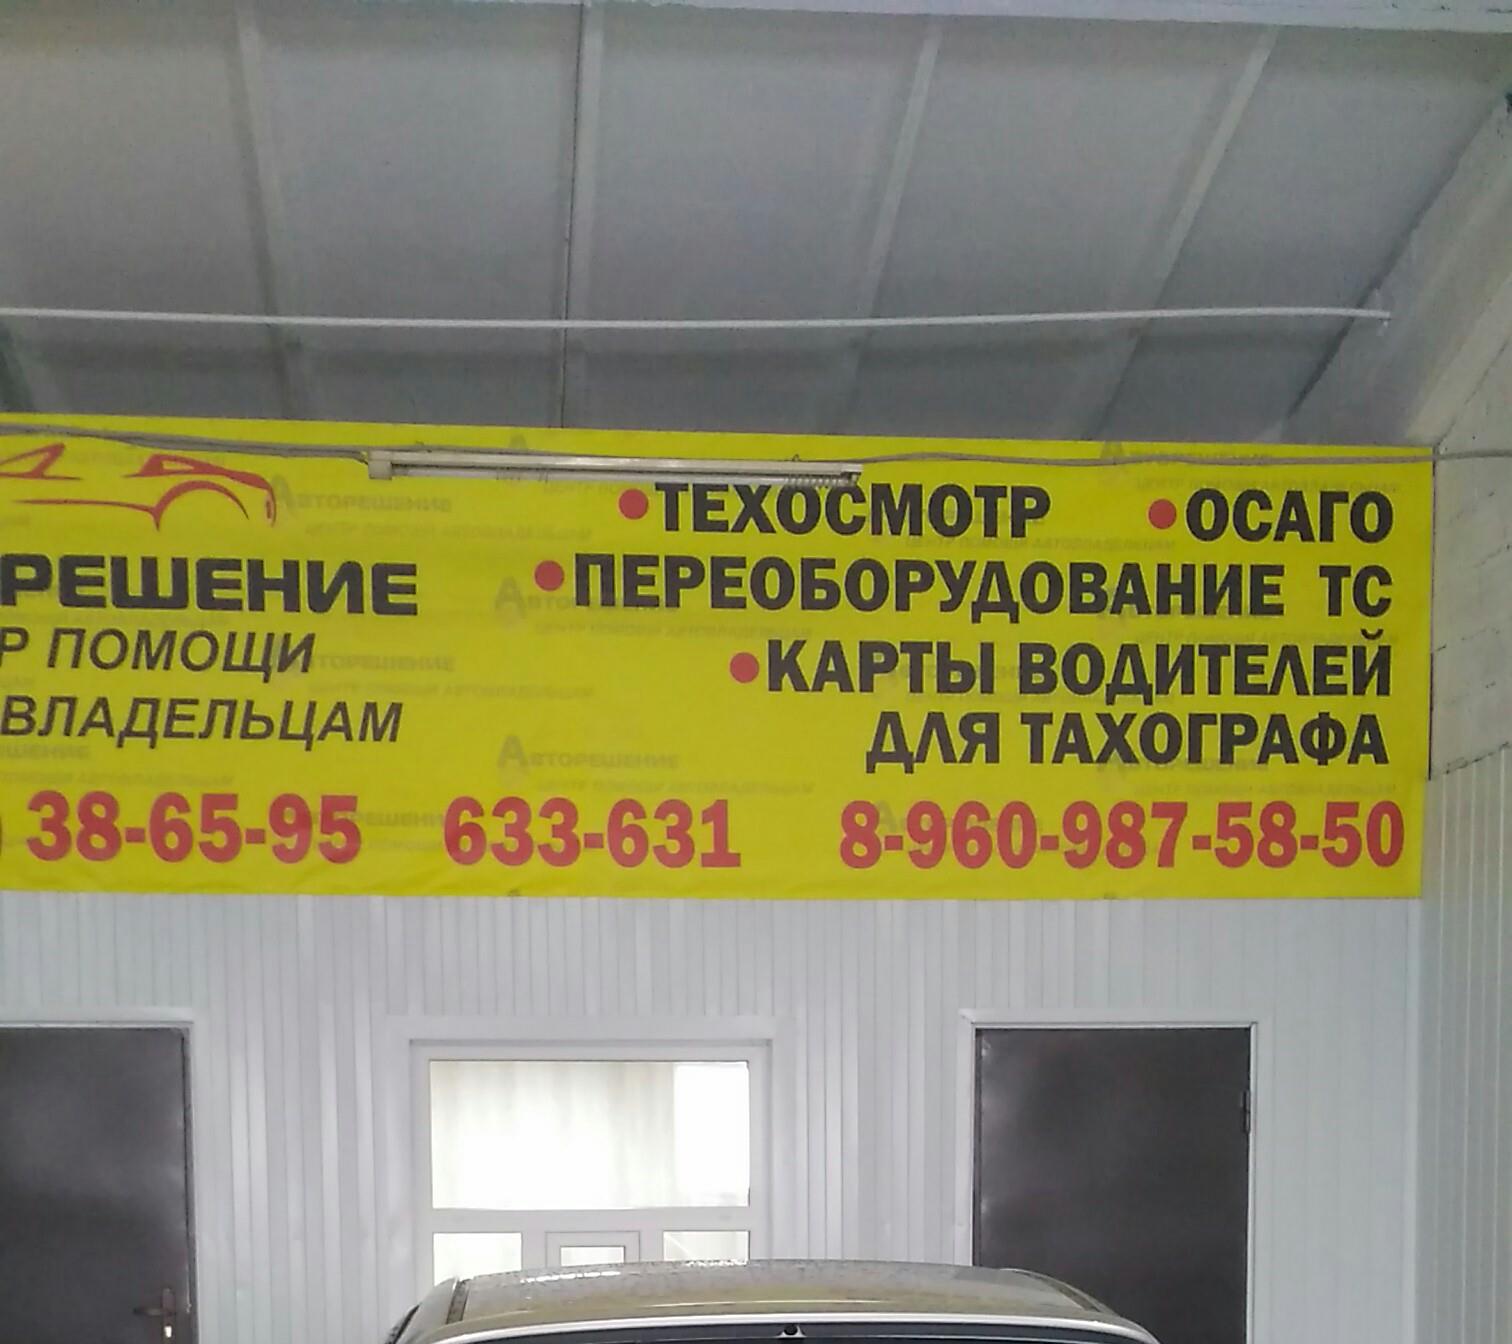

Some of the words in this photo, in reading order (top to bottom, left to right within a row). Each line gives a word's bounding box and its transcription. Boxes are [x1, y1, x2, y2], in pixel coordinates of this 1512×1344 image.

[654, 482, 1051, 538] ТЕХОСМОТР
[1186, 487, 1394, 543] ОСАГО
[0, 553, 418, 617] РЕШЕНИЕ
[574, 552, 1285, 624] ПЕРЕОБОРУДОВАНИЕ
[1318, 564, 1393, 617] ТС
[47, 627, 316, 683] ПОМОЩИ
[767, 639, 995, 694] КАРТЫ
[1018, 628, 1392, 706] ВОДИТЕЛЕЙ
[0, 694, 403, 751] ВЛАДЕЛЬЦАМ
[865, 711, 1000, 774] ДЛЯ
[1020, 711, 1390, 767] ТАХОГРАФА
[26, 790, 361, 864] 38-65-95
[443, 796, 741, 869] 633-631
[839, 799, 1404, 870] 8-960-987-58-50
